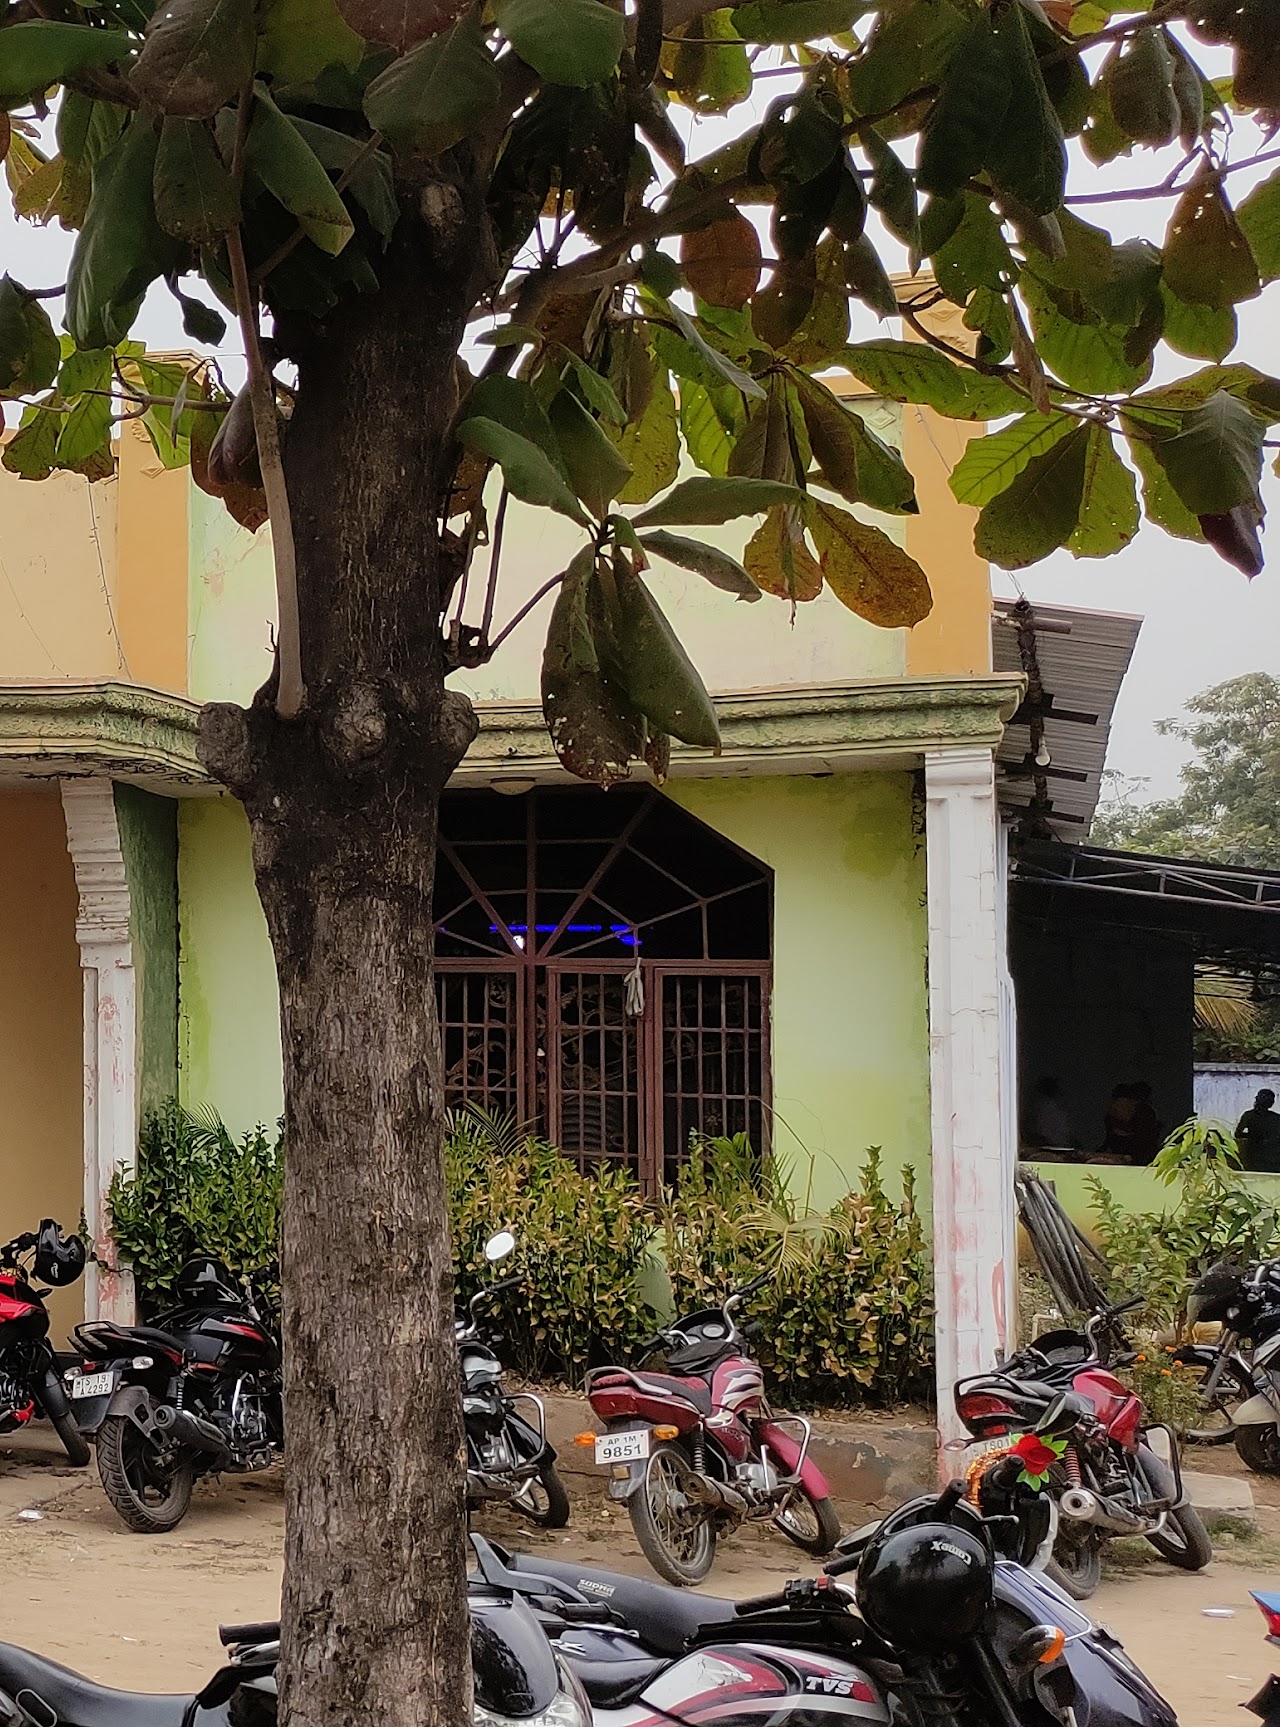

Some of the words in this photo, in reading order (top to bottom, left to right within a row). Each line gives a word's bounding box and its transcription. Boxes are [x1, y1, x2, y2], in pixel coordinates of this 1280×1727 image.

[87, 1383, 109, 1394] 4292
[607, 1437, 620, 1446] AP
[623, 1435, 637, 1443] 1M
[602, 1443, 642, 1459] 9851
[806, 1675, 854, 1695] TVS
